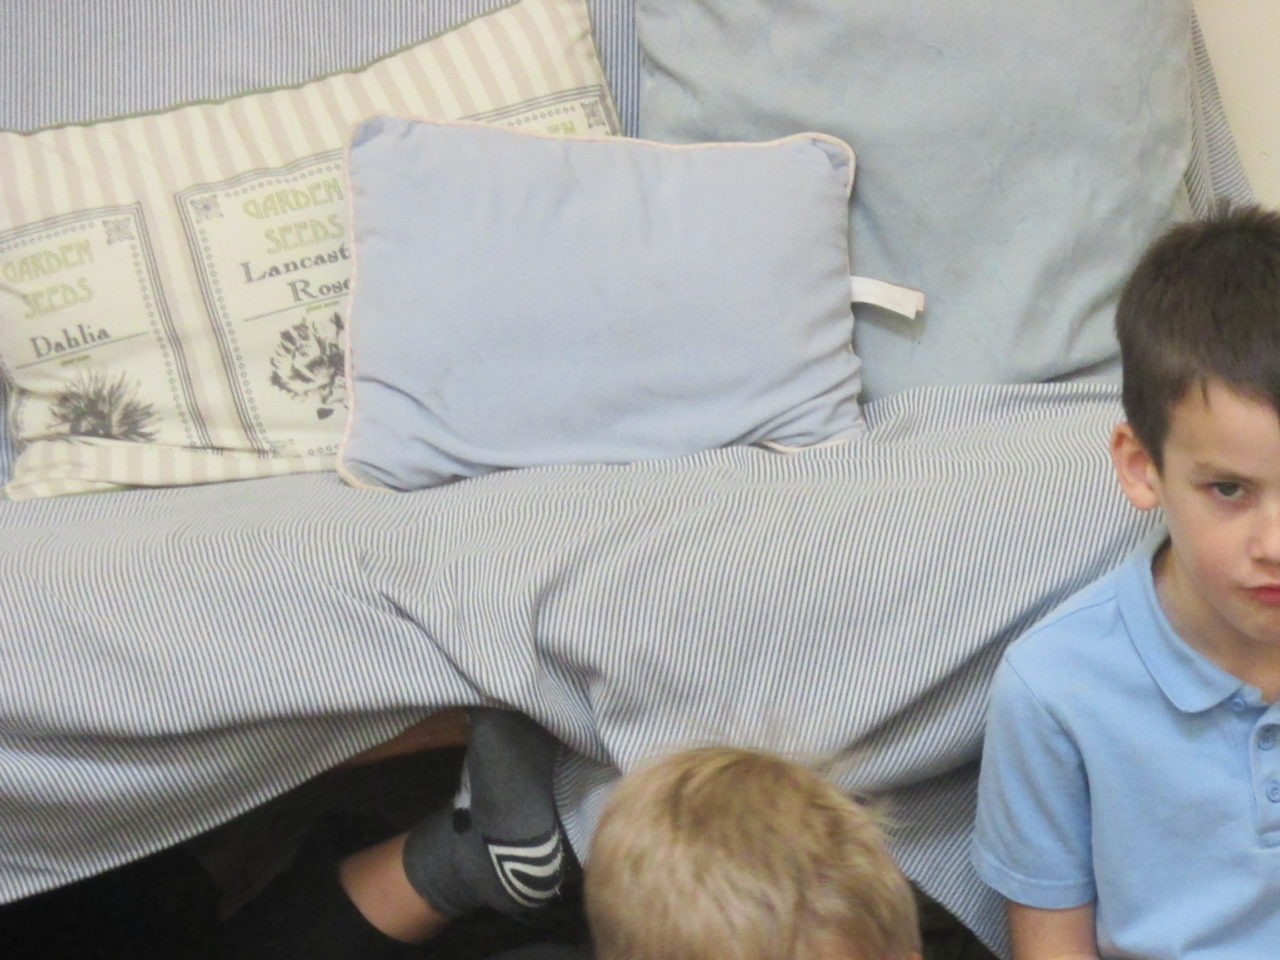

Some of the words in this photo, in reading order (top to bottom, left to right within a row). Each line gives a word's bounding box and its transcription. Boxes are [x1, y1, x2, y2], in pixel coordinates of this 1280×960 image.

[242, 178, 344, 220] GARDEN
[264, 214, 345, 254] SEEDS
[2, 239, 94, 283] GARDEN
[22, 277, 94, 320] SEEDS
[30, 324, 110, 358] Dahlia
